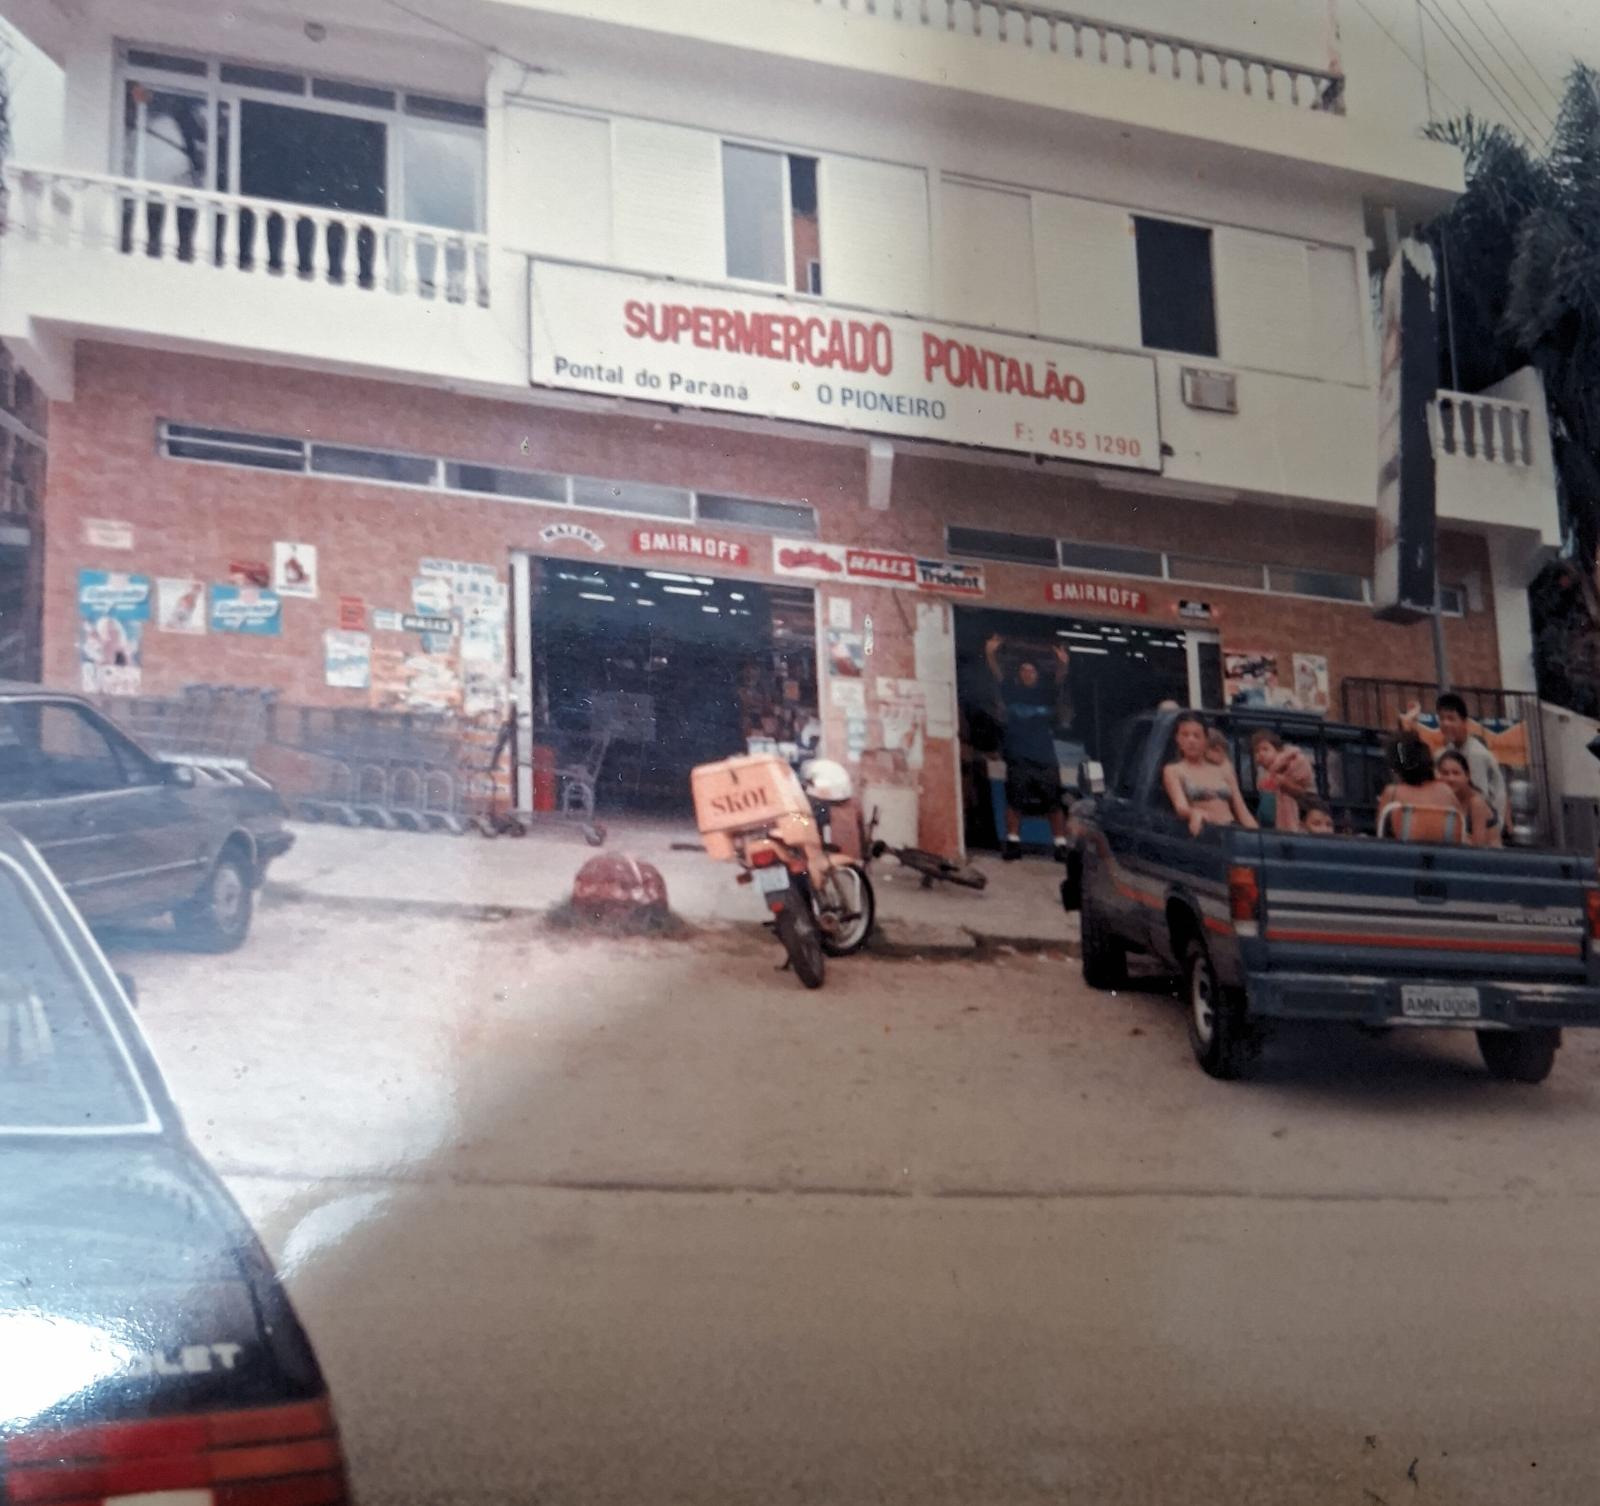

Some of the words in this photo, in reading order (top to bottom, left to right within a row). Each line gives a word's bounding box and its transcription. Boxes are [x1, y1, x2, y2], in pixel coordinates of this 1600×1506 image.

[624, 299, 893, 376] SUPERMERCADO
[922, 331, 1085, 405] PONTALÃO
[554, 356, 624, 385] Pontal
[635, 369, 662, 389] do
[817, 383, 833, 405] O
[840, 387, 947, 421] PIONEIRO
[1050, 427, 1087, 450] 455
[1095, 434, 1142, 458] 1290
[638, 531, 741, 561] SMIRNOFF
[851, 555, 911, 577] HALLS
[921, 569, 979, 589] Trident
[1051, 583, 1140, 608] SMIRNOFF
